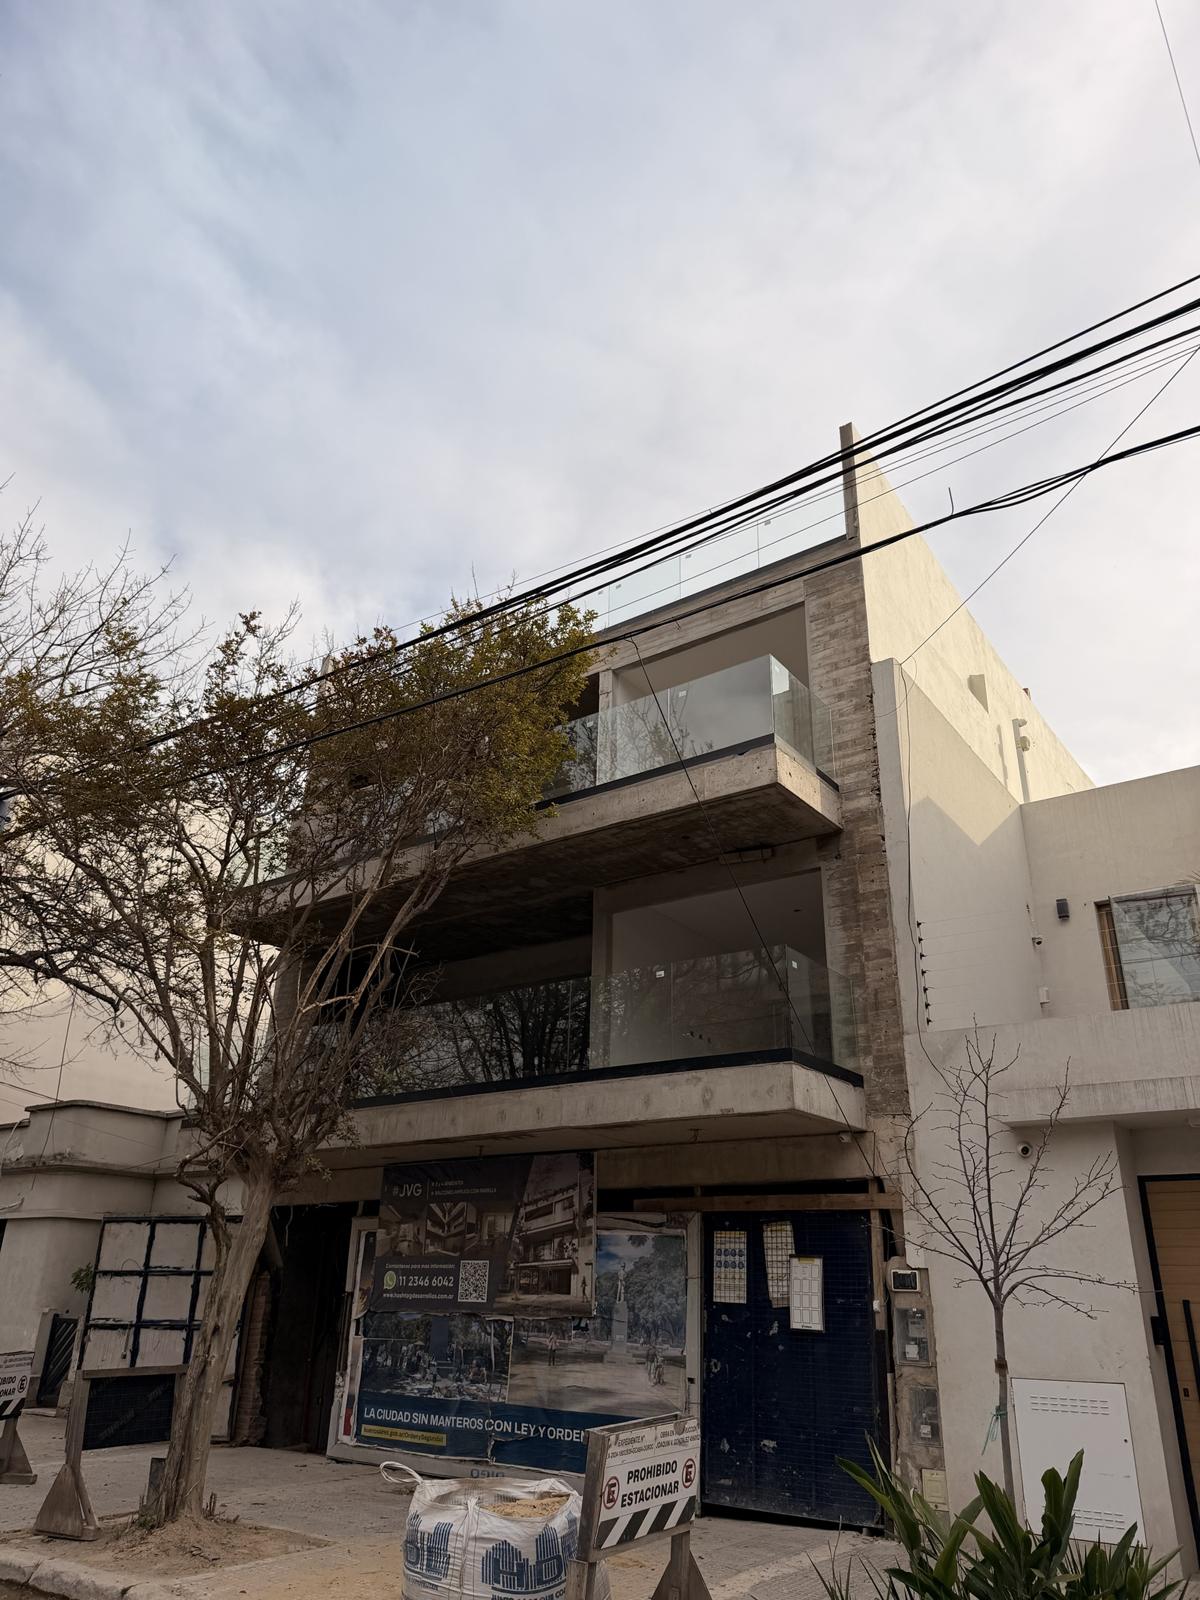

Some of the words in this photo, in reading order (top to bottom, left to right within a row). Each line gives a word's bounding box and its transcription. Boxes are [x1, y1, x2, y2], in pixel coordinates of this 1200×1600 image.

[399, 1276, 406, 1287] 11
[408, 1276, 430, 1287] 2346
[431, 1276, 454, 1287] 6042
[364, 1407, 376, 1419] LA
[376, 1408, 411, 1423] CIUDAD
[411, 1412, 429, 1425] SIN
[430, 1414, 484, 1431] MANTEROS
[484, 1419, 512, 1433] CON
[514, 1422, 536, 1437] LEY
[538, 1426, 546, 1438] Y
[627, 1460, 678, 1484] PROHIBIDO
[620, 1480, 679, 1508] ESTACIONAR
